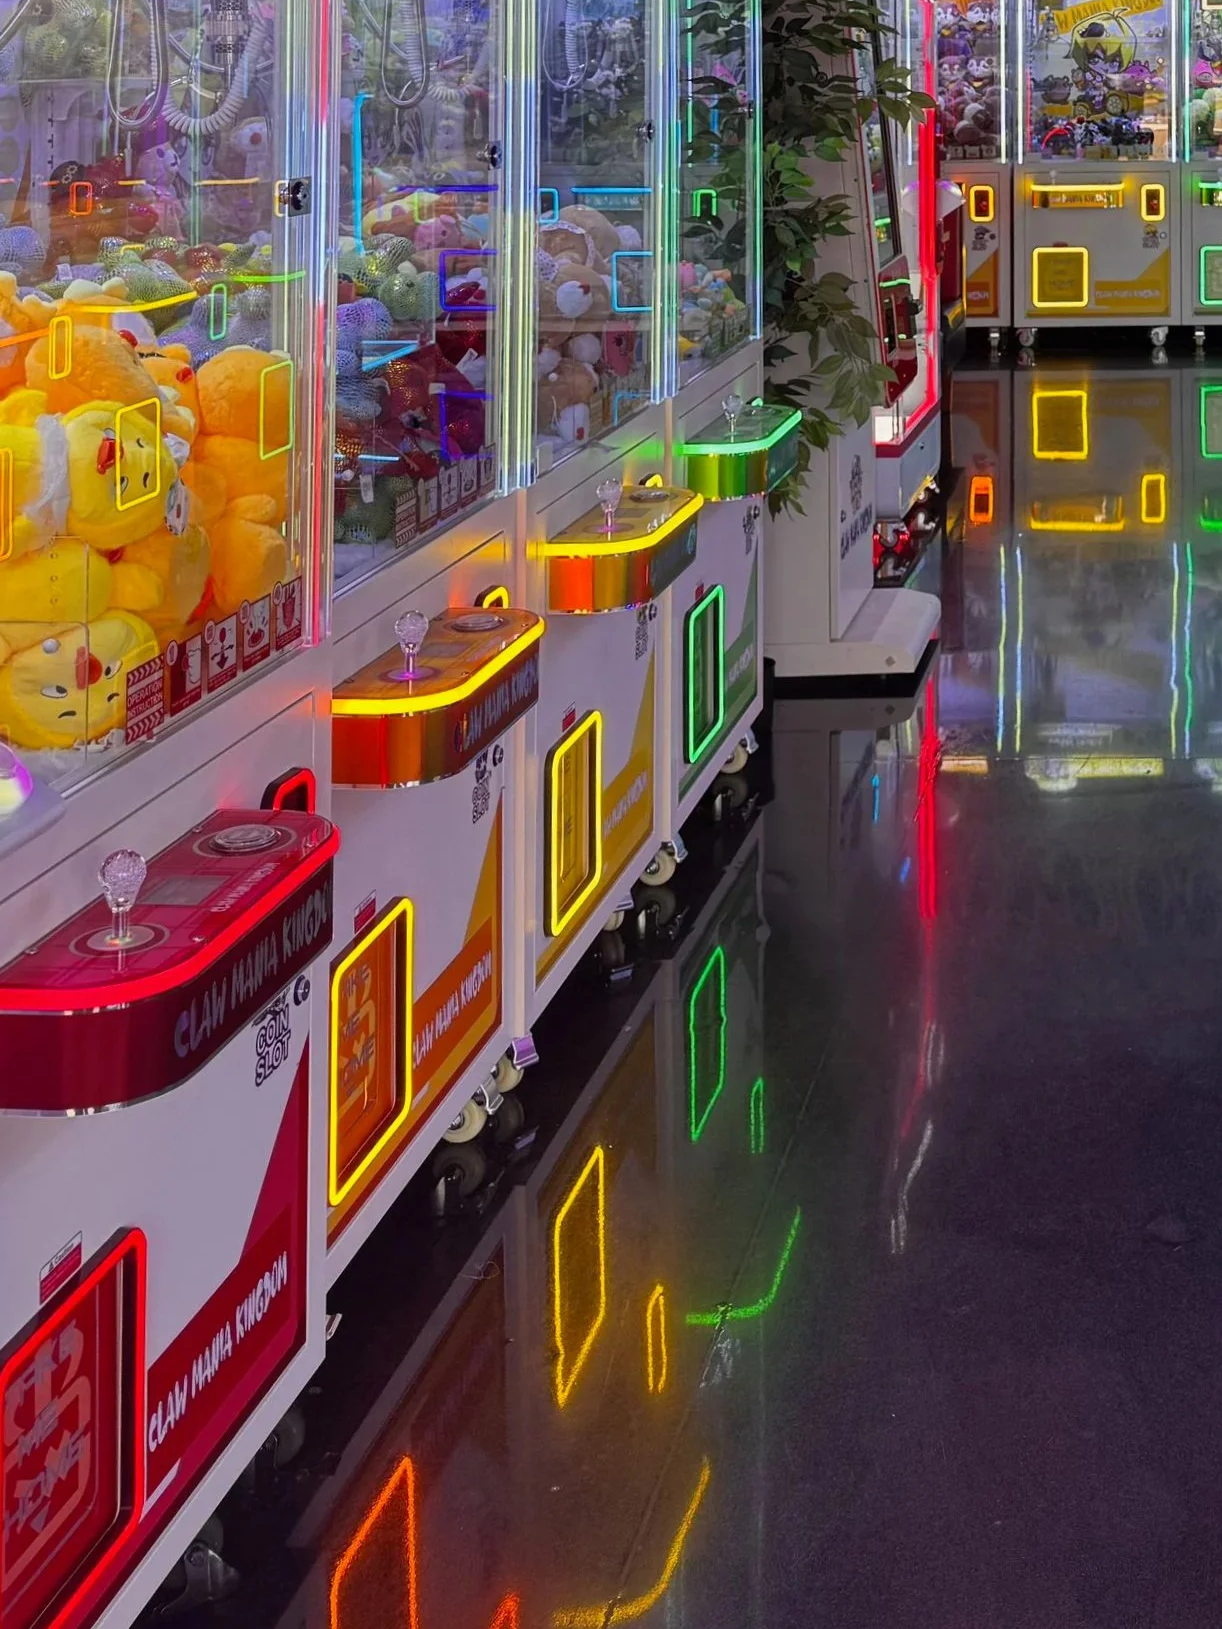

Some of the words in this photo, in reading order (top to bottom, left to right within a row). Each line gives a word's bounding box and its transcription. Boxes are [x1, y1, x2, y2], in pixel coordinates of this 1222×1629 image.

[128, 678, 163, 709] OPERATION
[128, 692, 163, 719] INSTRUCTION
[174, 977, 227, 1059] CLAW
[231, 931, 278, 1011] MANIA
[435, 999, 460, 1041] MANIA
[255, 1004, 290, 1058] COIN
[254, 1031, 291, 1088] SLOT
[147, 1373, 188, 1453] CLAW
[191, 1321, 233, 1399] MANIA
[235, 1250, 288, 1345] KINGDOM
